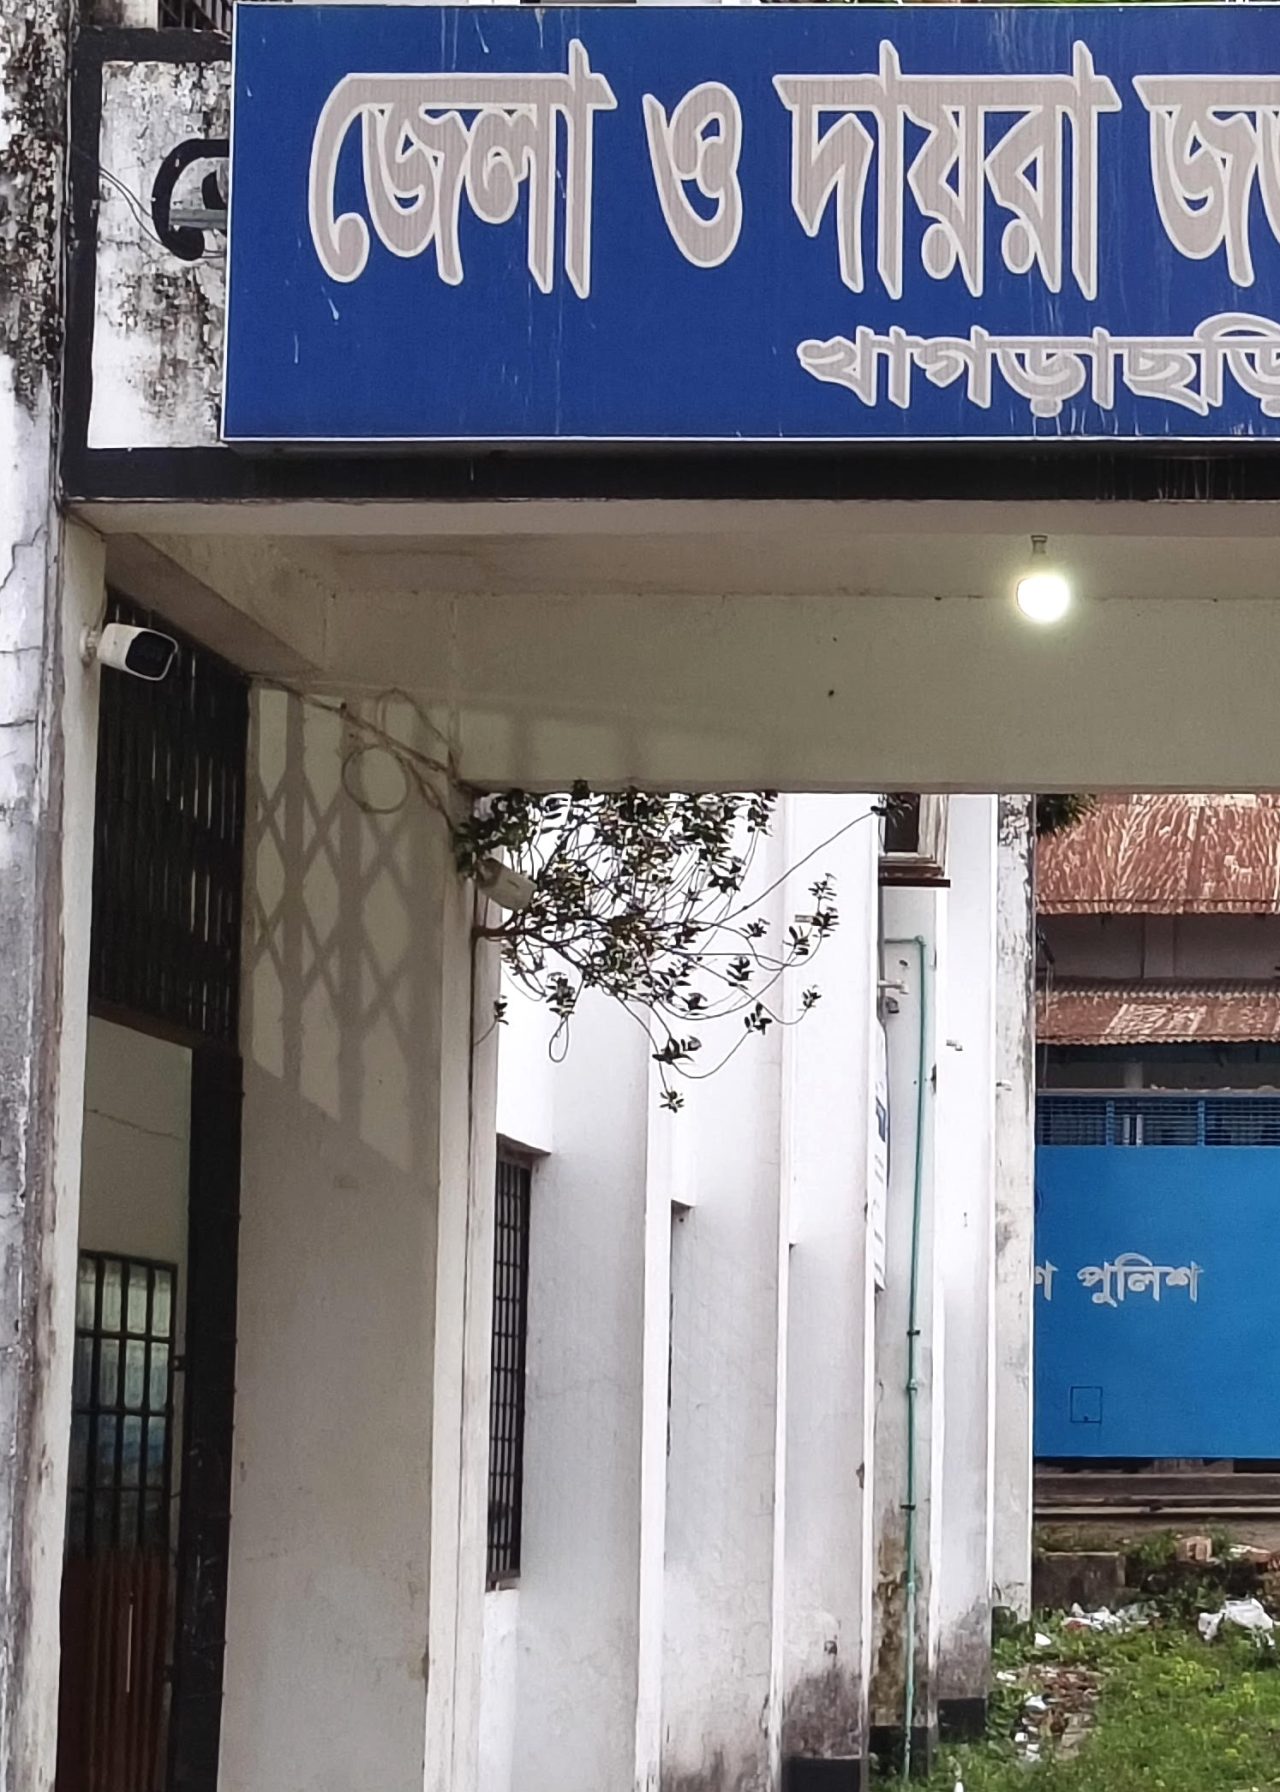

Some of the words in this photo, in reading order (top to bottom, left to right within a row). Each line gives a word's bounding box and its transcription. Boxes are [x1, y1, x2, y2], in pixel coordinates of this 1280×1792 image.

[309, 39, 617, 299] জেলা
[642, 82, 742, 267] ও
[772, 40, 1122, 300] দায়রা
[1077, 1252, 1204, 1308] পুলিশ
